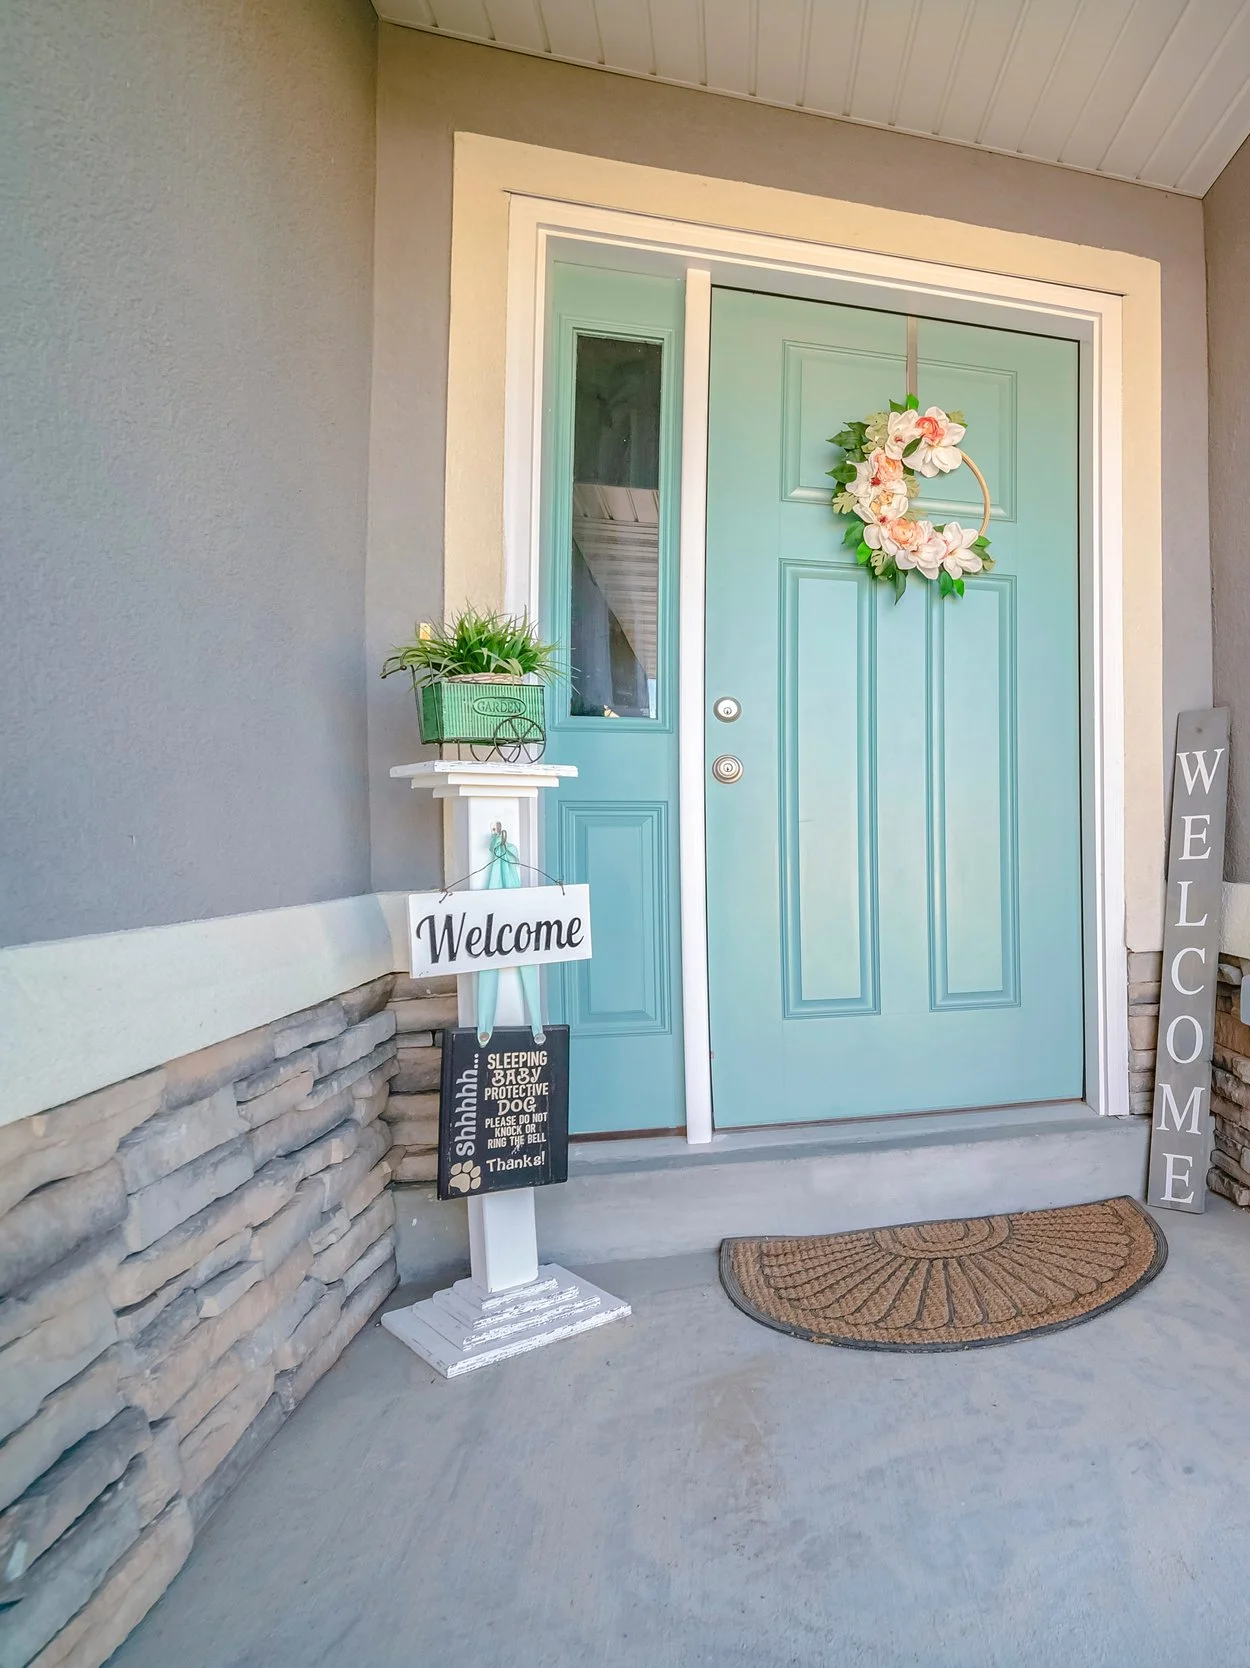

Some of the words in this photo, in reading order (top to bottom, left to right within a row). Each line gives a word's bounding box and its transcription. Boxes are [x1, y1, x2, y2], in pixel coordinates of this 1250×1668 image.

[477, 701, 521, 713] GARDEN
[416, 912, 584, 964] Welcome
[1155, 748, 1225, 1205] WELCOME
[487, 1051, 547, 1069] SLEEPING
[492, 1067, 541, 1086] BABY
[484, 1082, 549, 1101] PROTECTIVE
[454, 1053, 479, 1157] Shhhhh...
[497, 1097, 536, 1115] DOG
[485, 1117, 516, 1129] PLEASE
[519, 1115, 530, 1124] DO
[532, 1112, 548, 1123] NOT
[494, 1126, 523, 1138] KNOCK
[525, 1123, 536, 1133] OR
[487, 1137, 507, 1150] RING
[509, 1135, 525, 1145] THE
[527, 1132, 547, 1144] BELL
[486, 1151, 545, 1173] Thanks!
